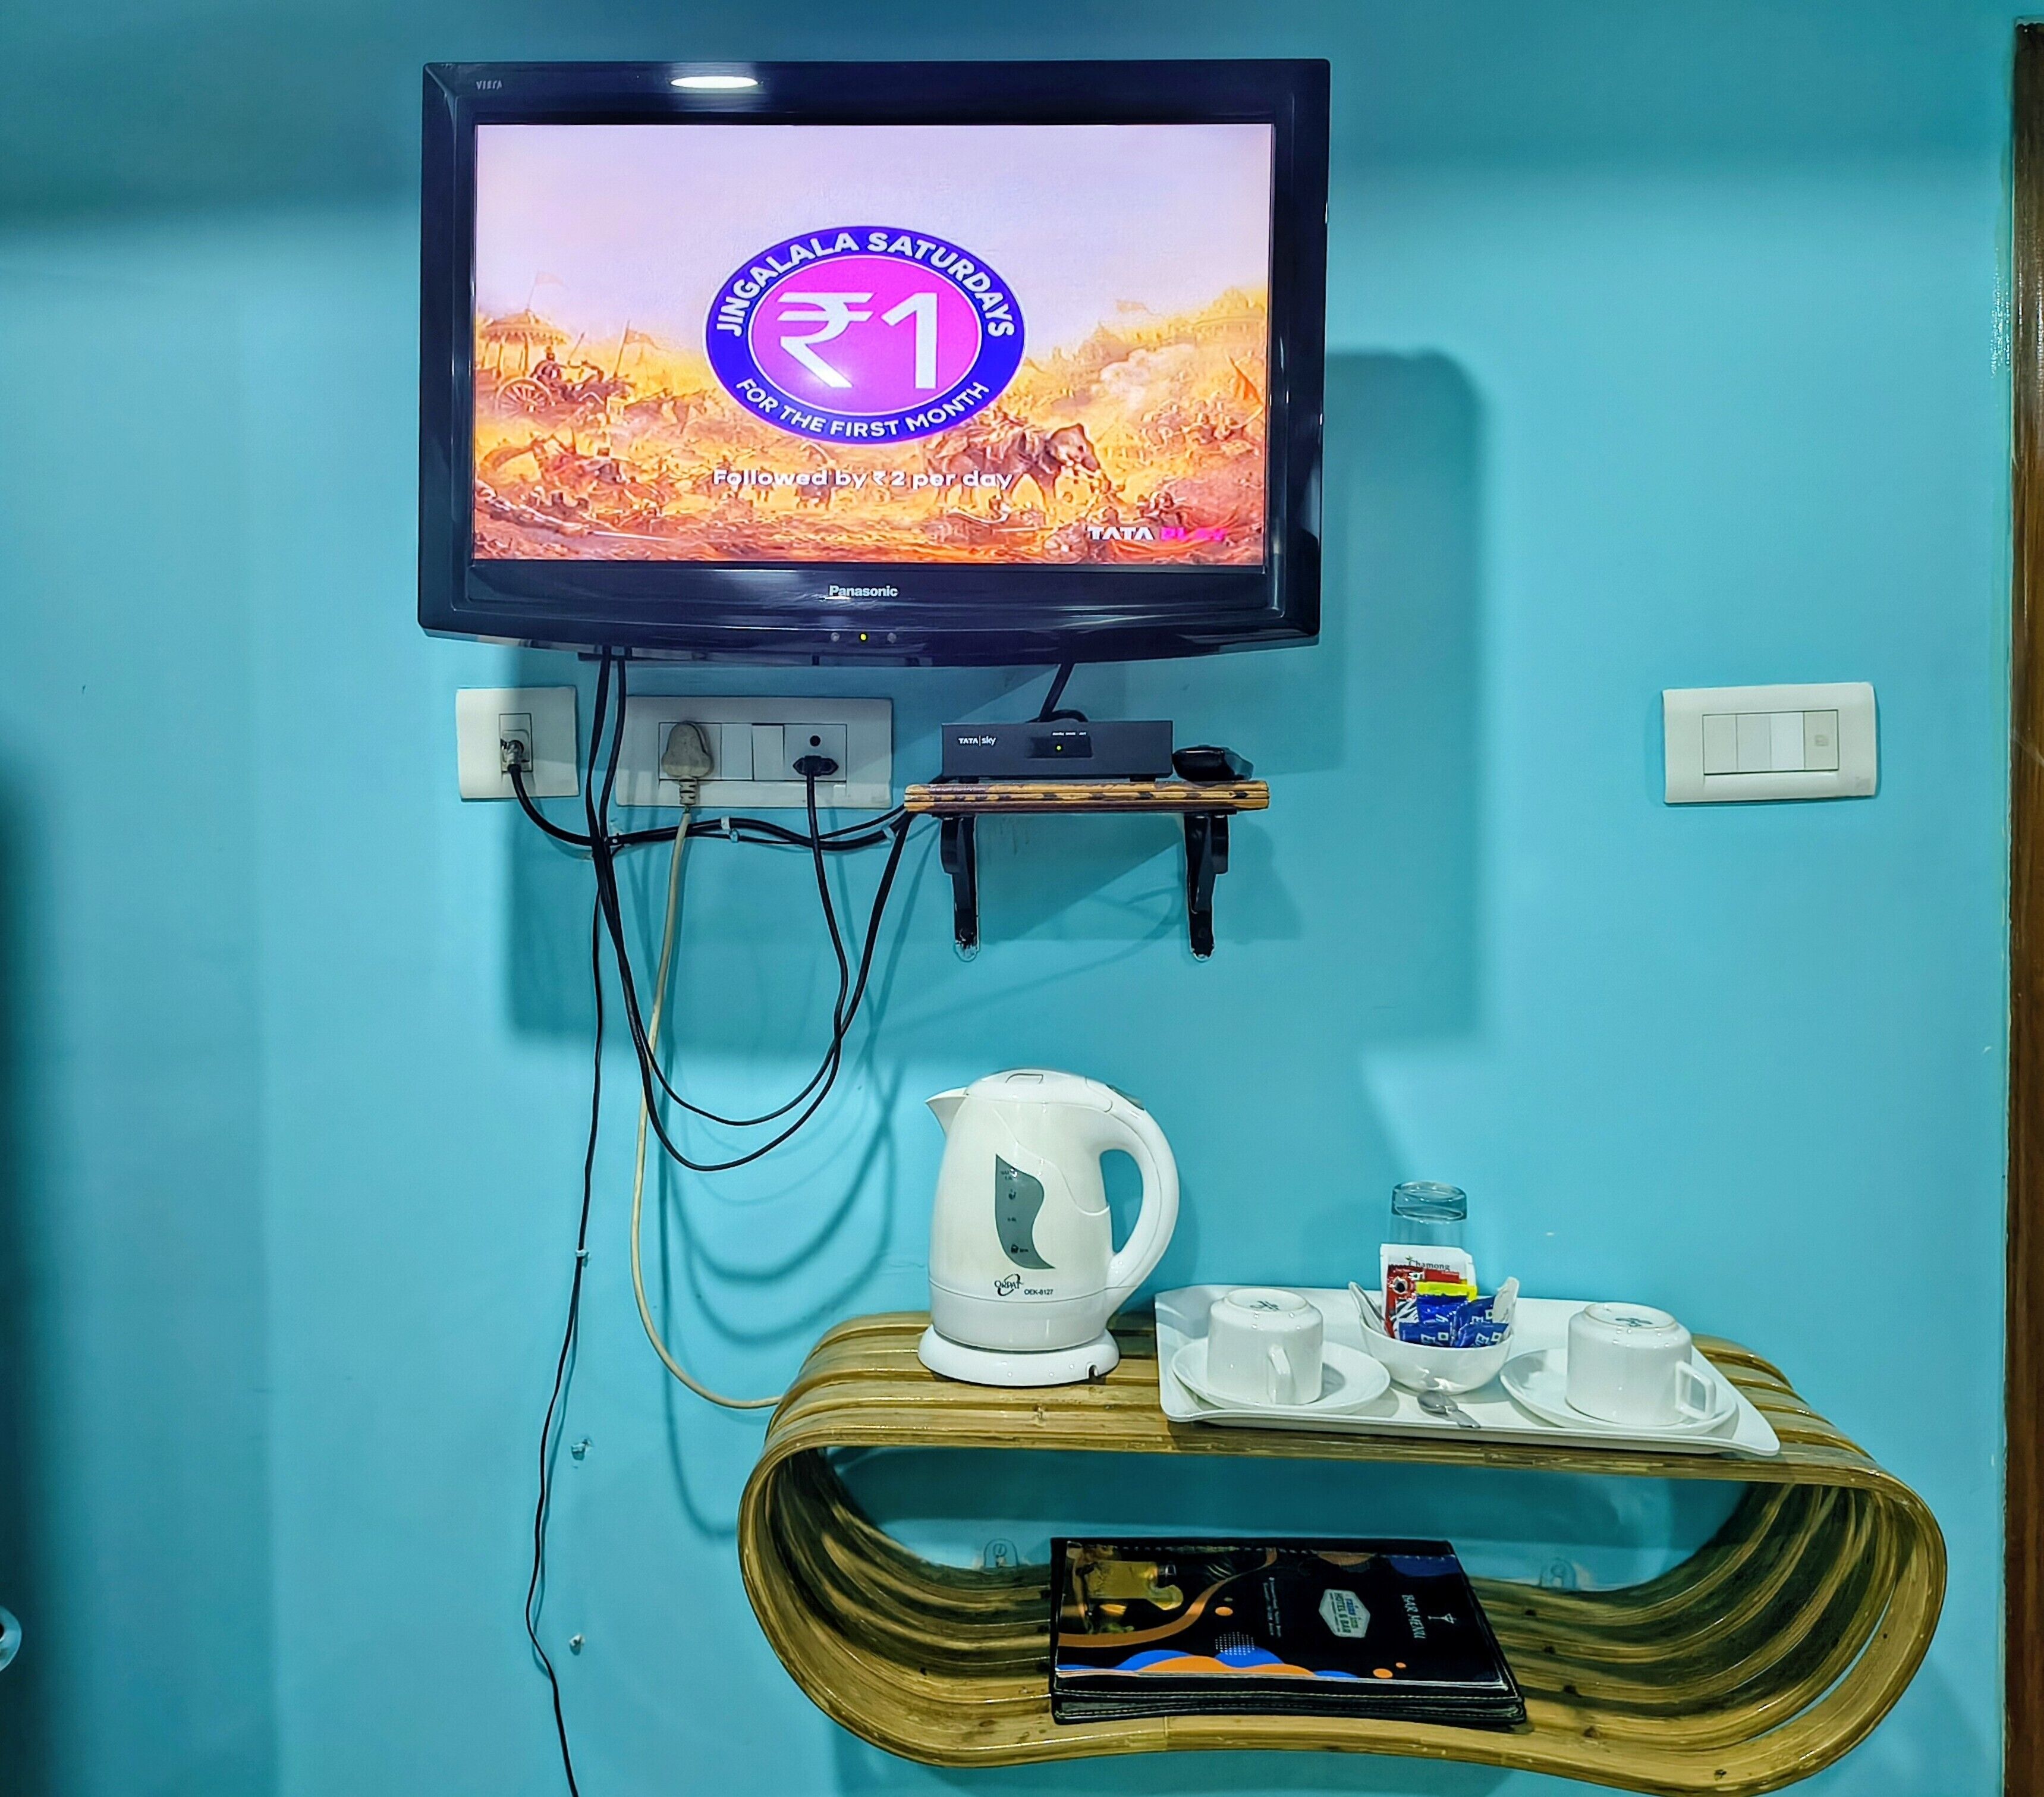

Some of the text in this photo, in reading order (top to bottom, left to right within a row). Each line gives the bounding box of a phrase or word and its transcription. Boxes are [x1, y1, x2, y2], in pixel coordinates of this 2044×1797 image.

[716, 231, 1014, 337] JINGALALA SATURDAYS
[735, 378, 989, 437] FOR THE FIRST MONTH
[713, 469, 828, 486] Followed
[835, 469, 867, 490] by
[912, 472, 957, 490] per
[963, 469, 1012, 490] day
[1087, 526, 1155, 541] TATA
[829, 585, 898, 597] Panasonic
[1402, 1595, 1426, 1640] BAR MENU
